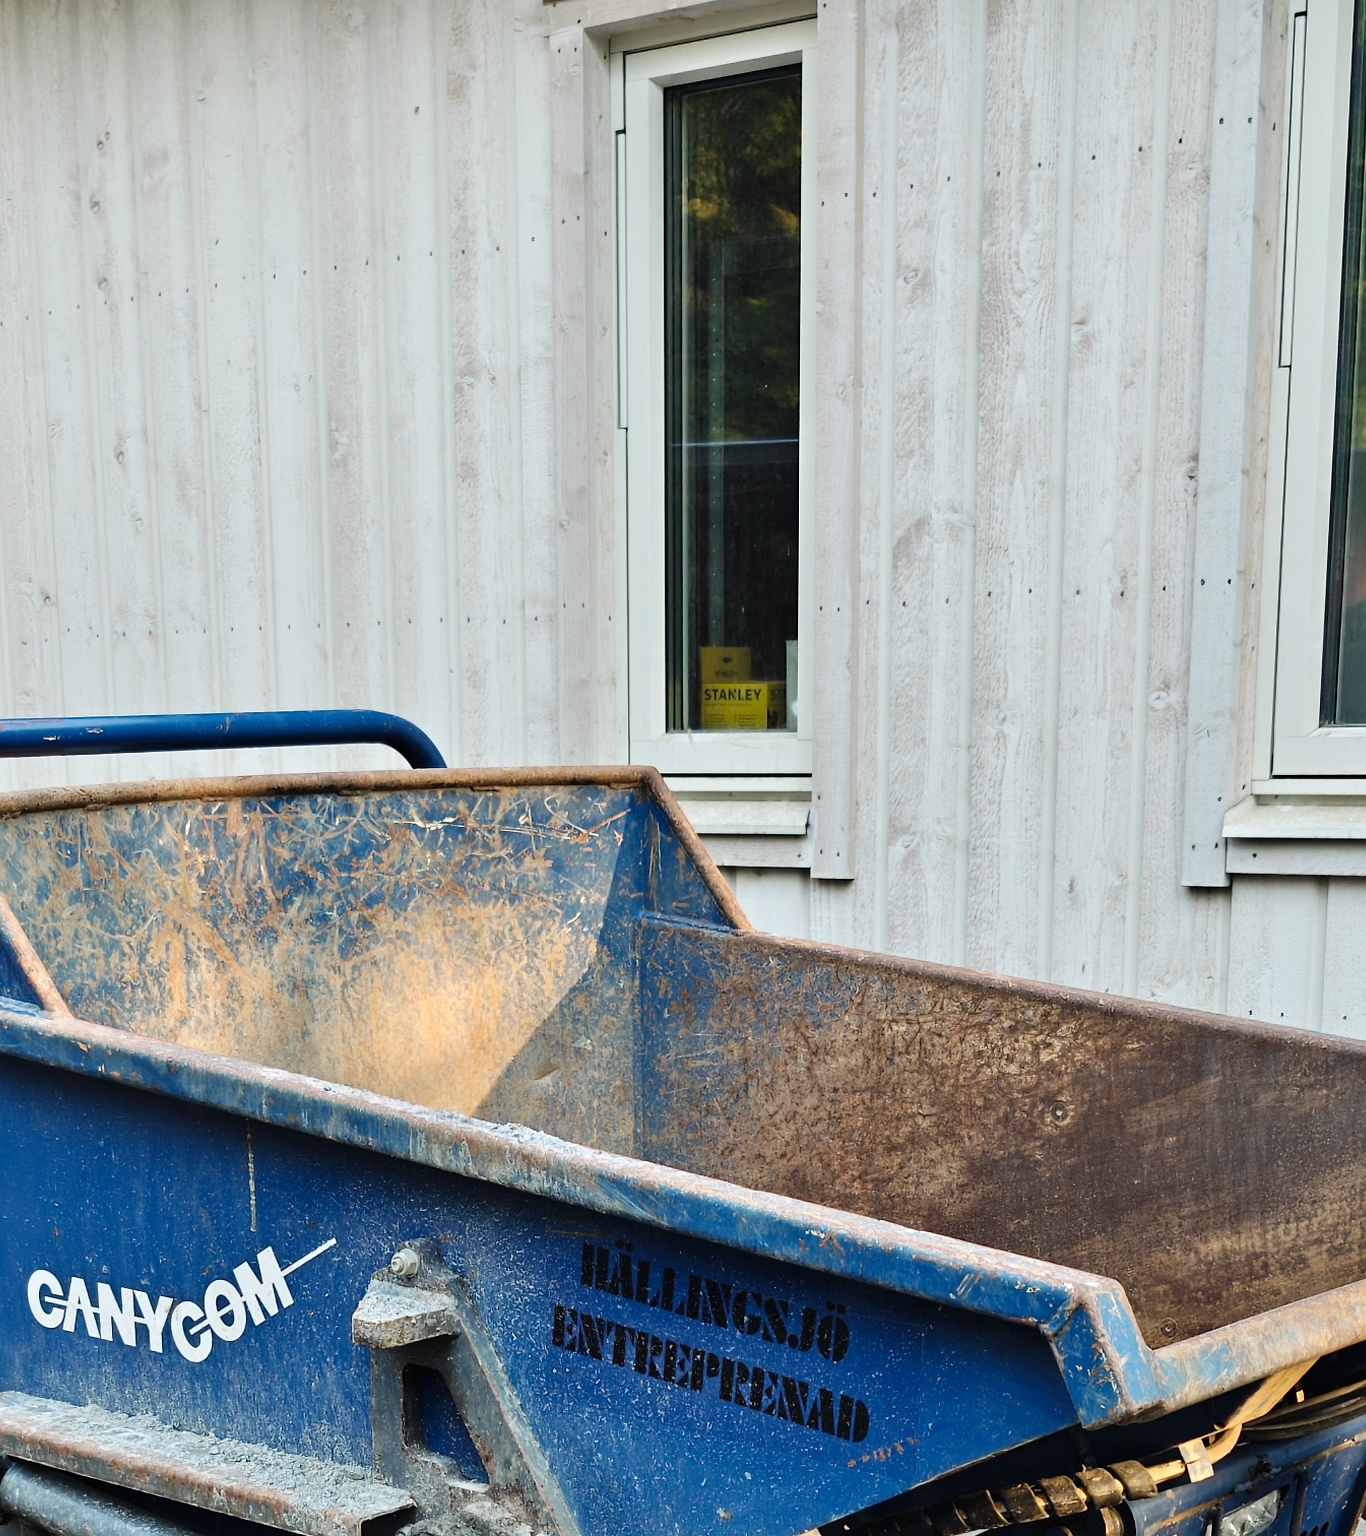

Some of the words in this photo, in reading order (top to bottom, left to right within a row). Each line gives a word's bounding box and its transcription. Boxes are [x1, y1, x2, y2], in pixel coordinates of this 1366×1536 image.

[704, 689, 762, 701] STANLEY
[27, 1245, 295, 1363] CANYCOM
[581, 1240, 850, 1362] HÄLLINGSJÖ
[552, 1304, 870, 1443] ENTREPRENAD
